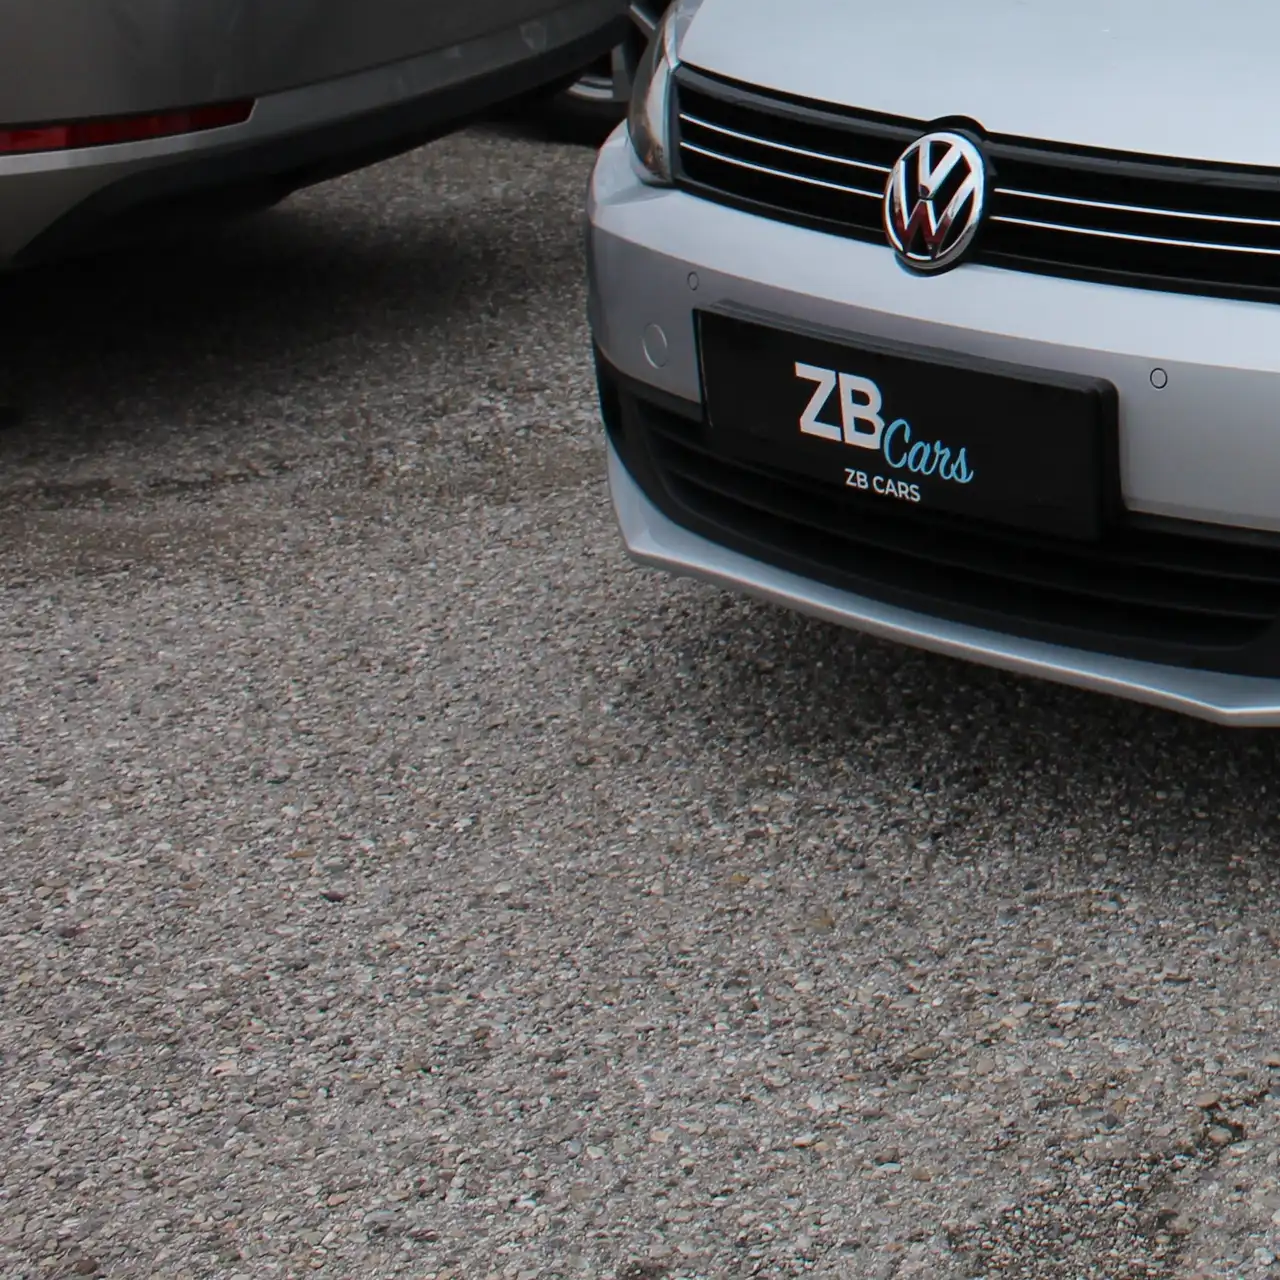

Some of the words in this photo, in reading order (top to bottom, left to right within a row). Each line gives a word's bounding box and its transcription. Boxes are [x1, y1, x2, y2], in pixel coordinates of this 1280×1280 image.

[795, 361, 885, 450] ZB
[883, 418, 974, 484] Cars
[845, 468, 869, 490] ZB
[873, 476, 921, 503] CARS
